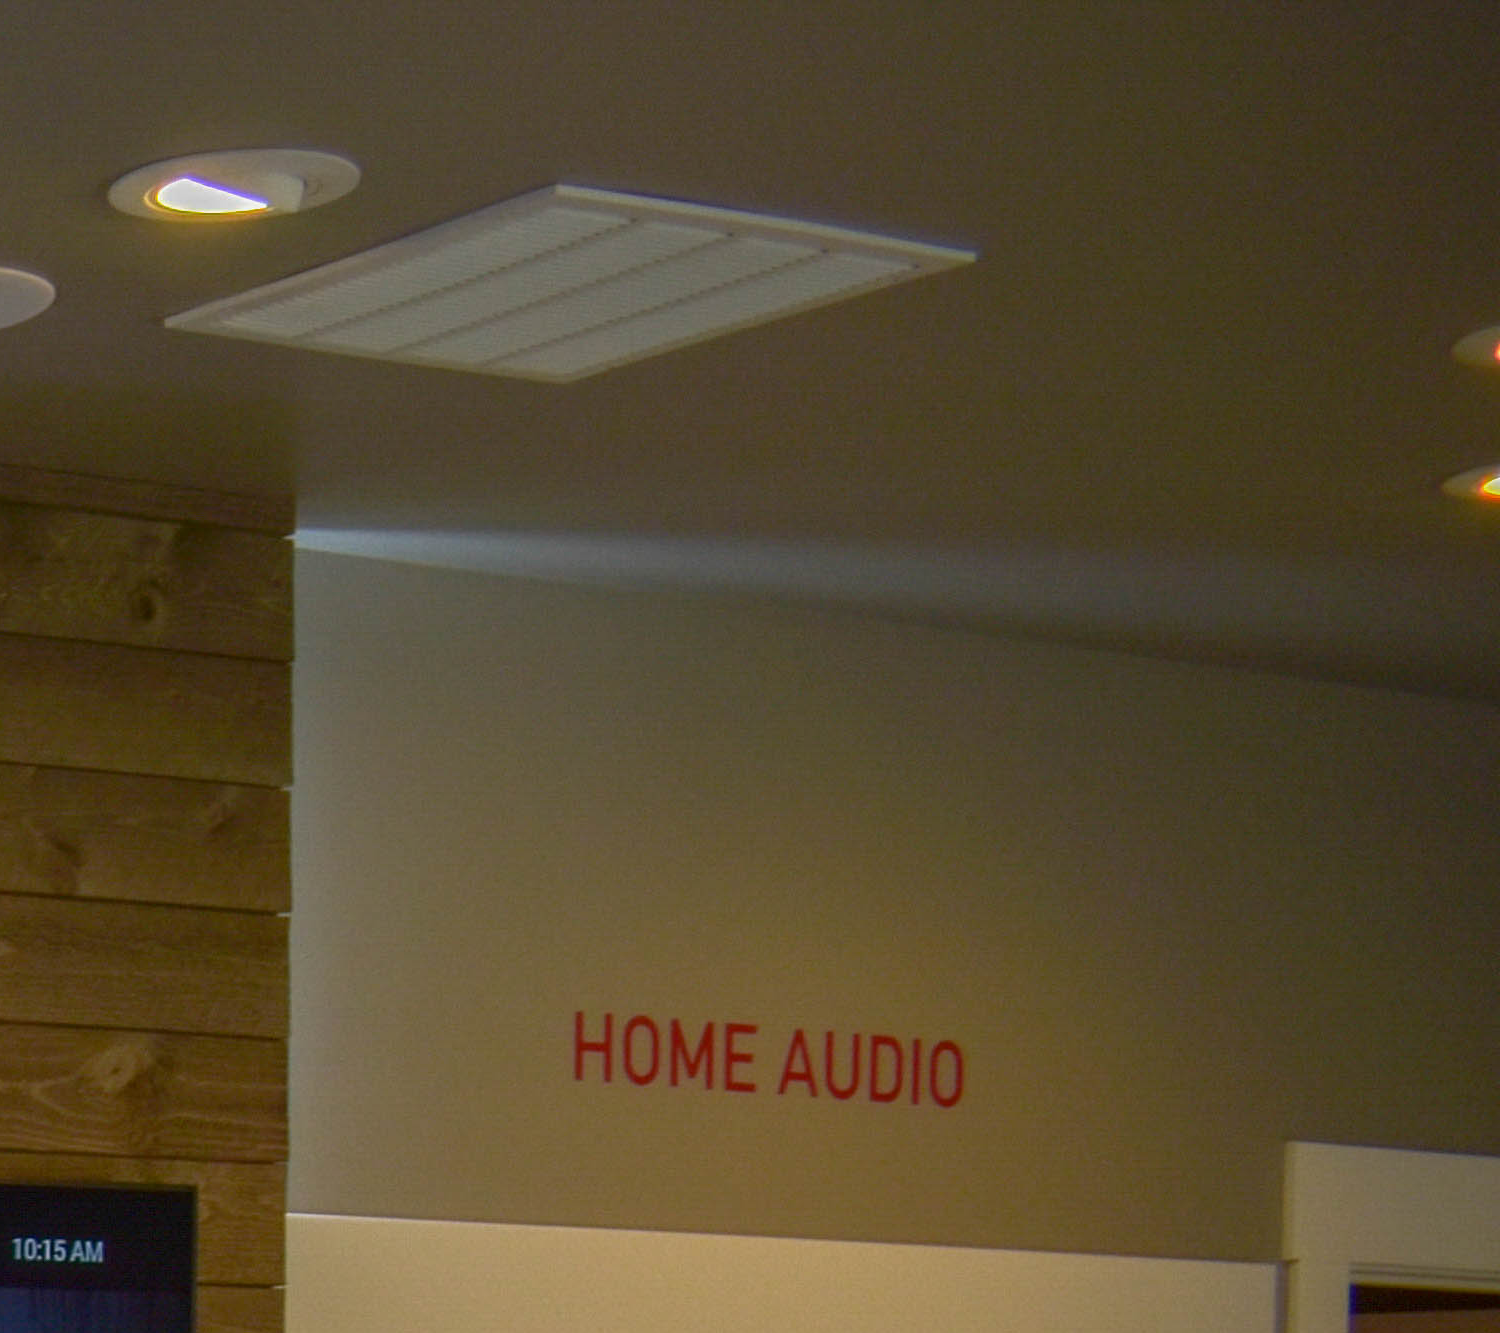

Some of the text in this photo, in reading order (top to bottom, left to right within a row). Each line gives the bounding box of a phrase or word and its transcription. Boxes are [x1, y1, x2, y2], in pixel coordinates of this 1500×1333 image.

[573, 1010, 965, 1109] HOME AUDIO
[11, 1237, 104, 1263] 10:15 AM
